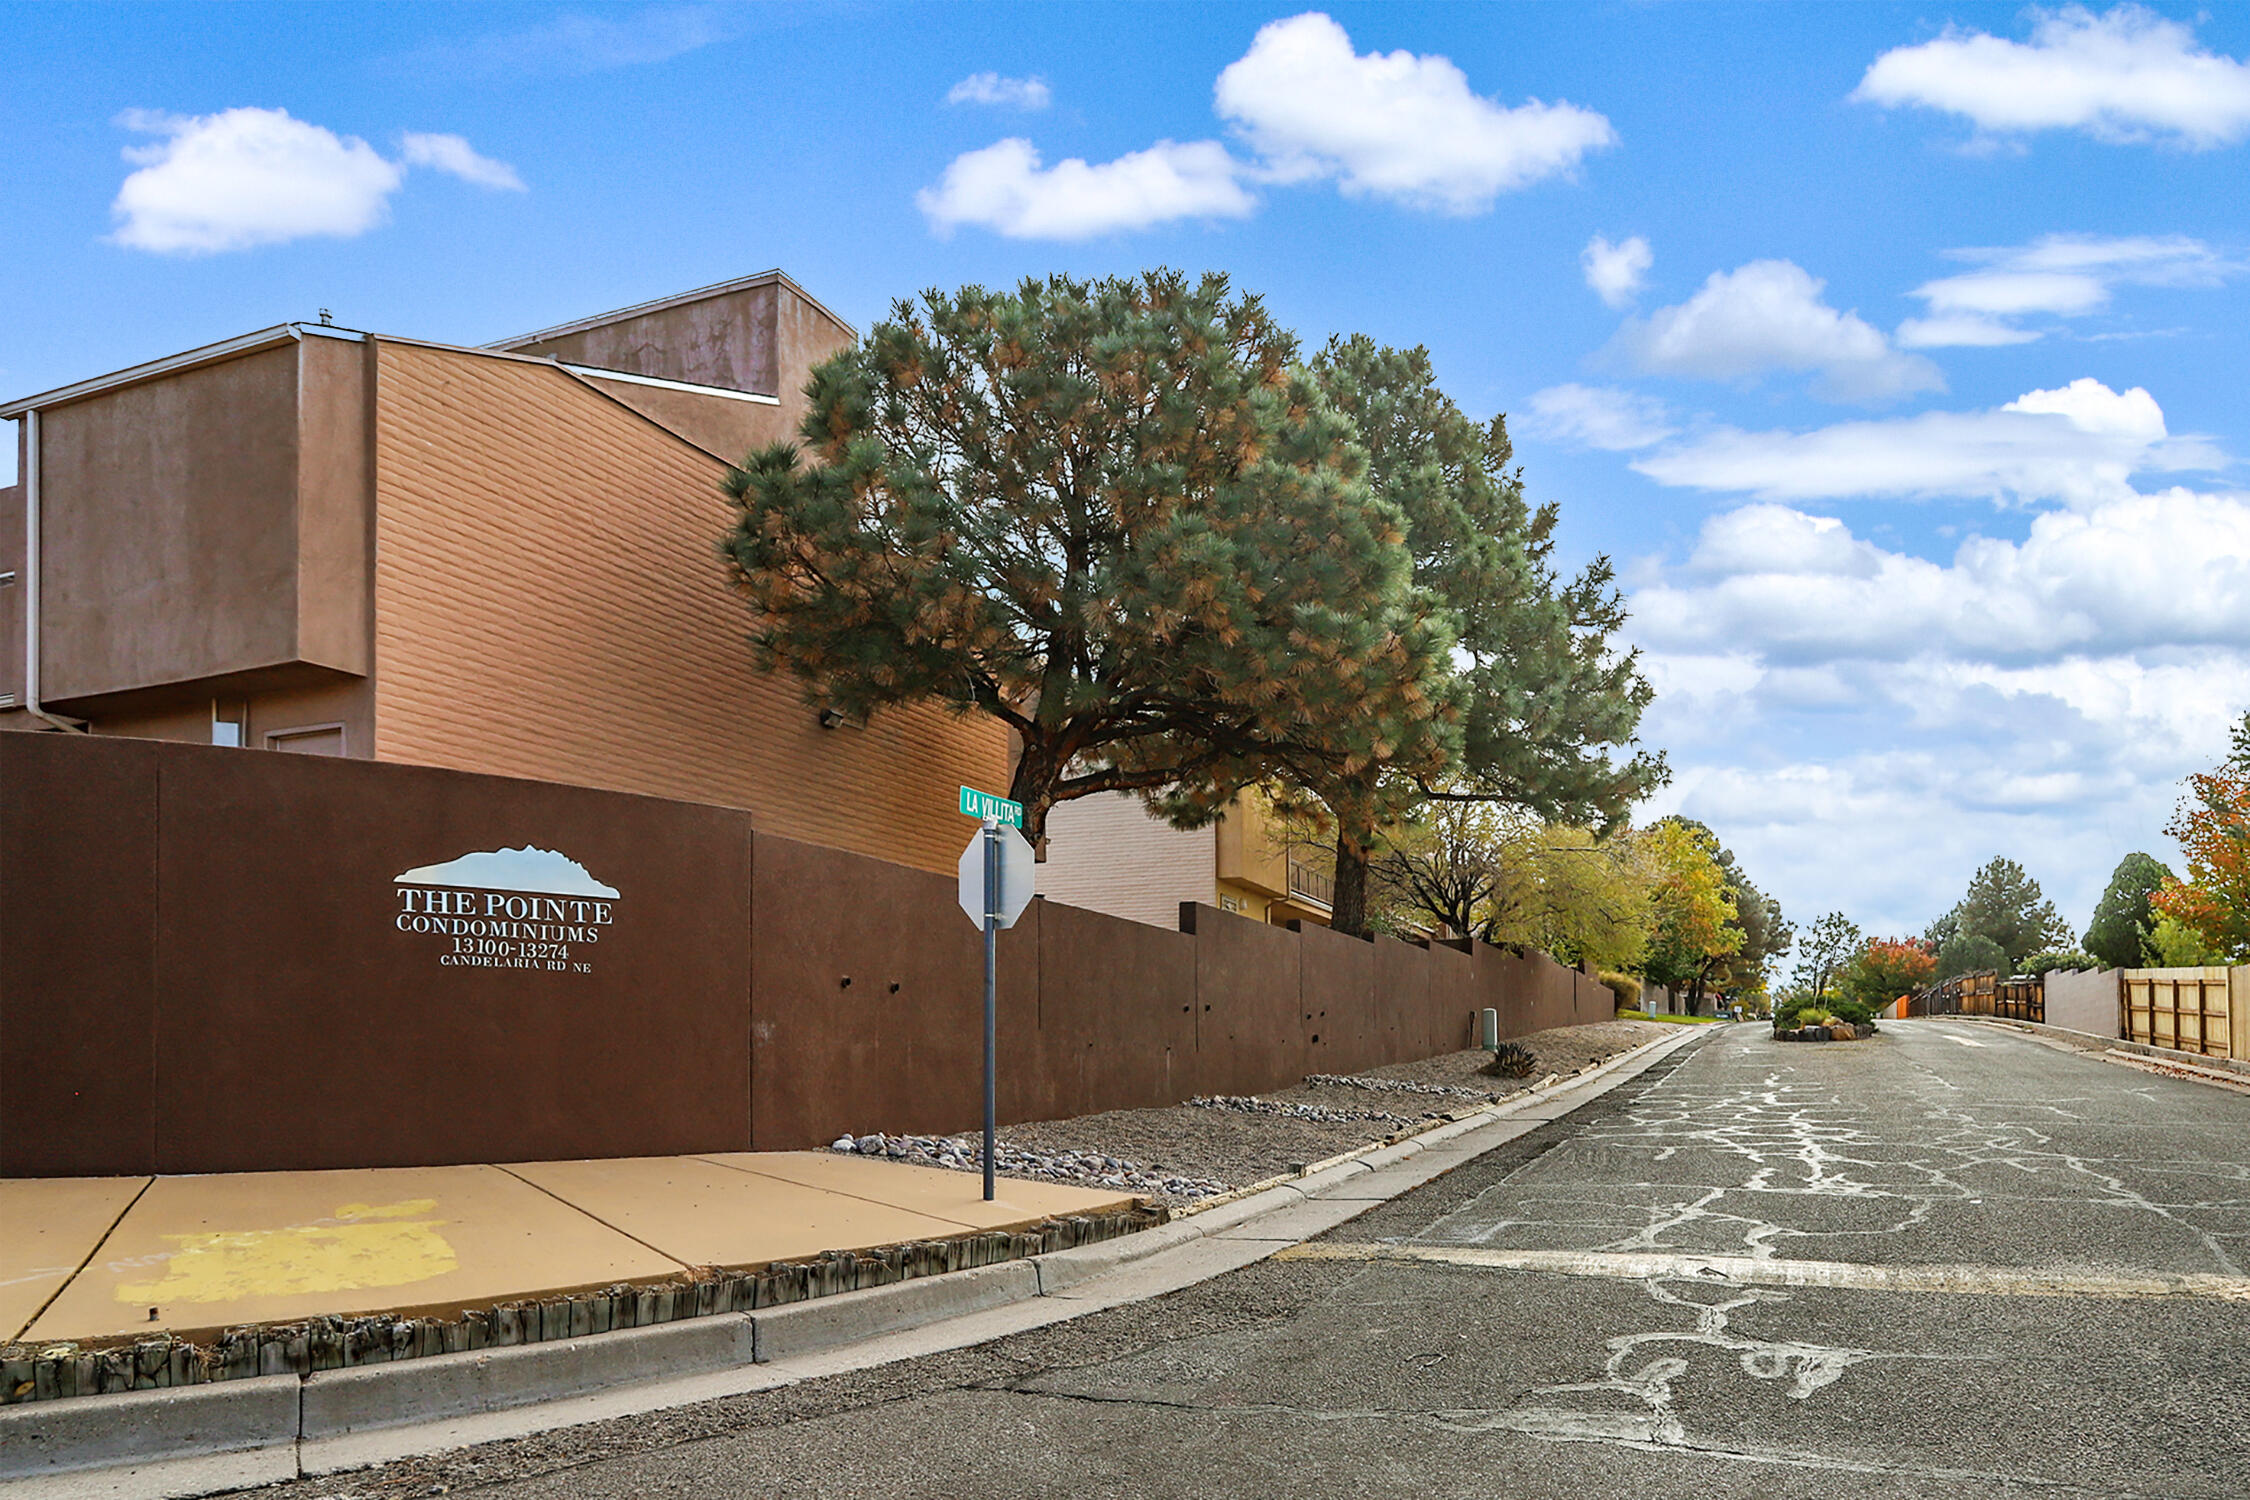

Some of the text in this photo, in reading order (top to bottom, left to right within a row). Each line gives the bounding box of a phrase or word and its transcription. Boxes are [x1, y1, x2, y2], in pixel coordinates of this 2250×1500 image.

[966, 792, 978, 814] LA
[982, 797, 1015, 823] VILLITA
[397, 888, 613, 925] THE POINTE
[396, 914, 599, 943] CONDOMINIUMS
[452, 937, 569, 960] 13100-13274
[440, 954, 592, 974] CANDELARIA RD NE
